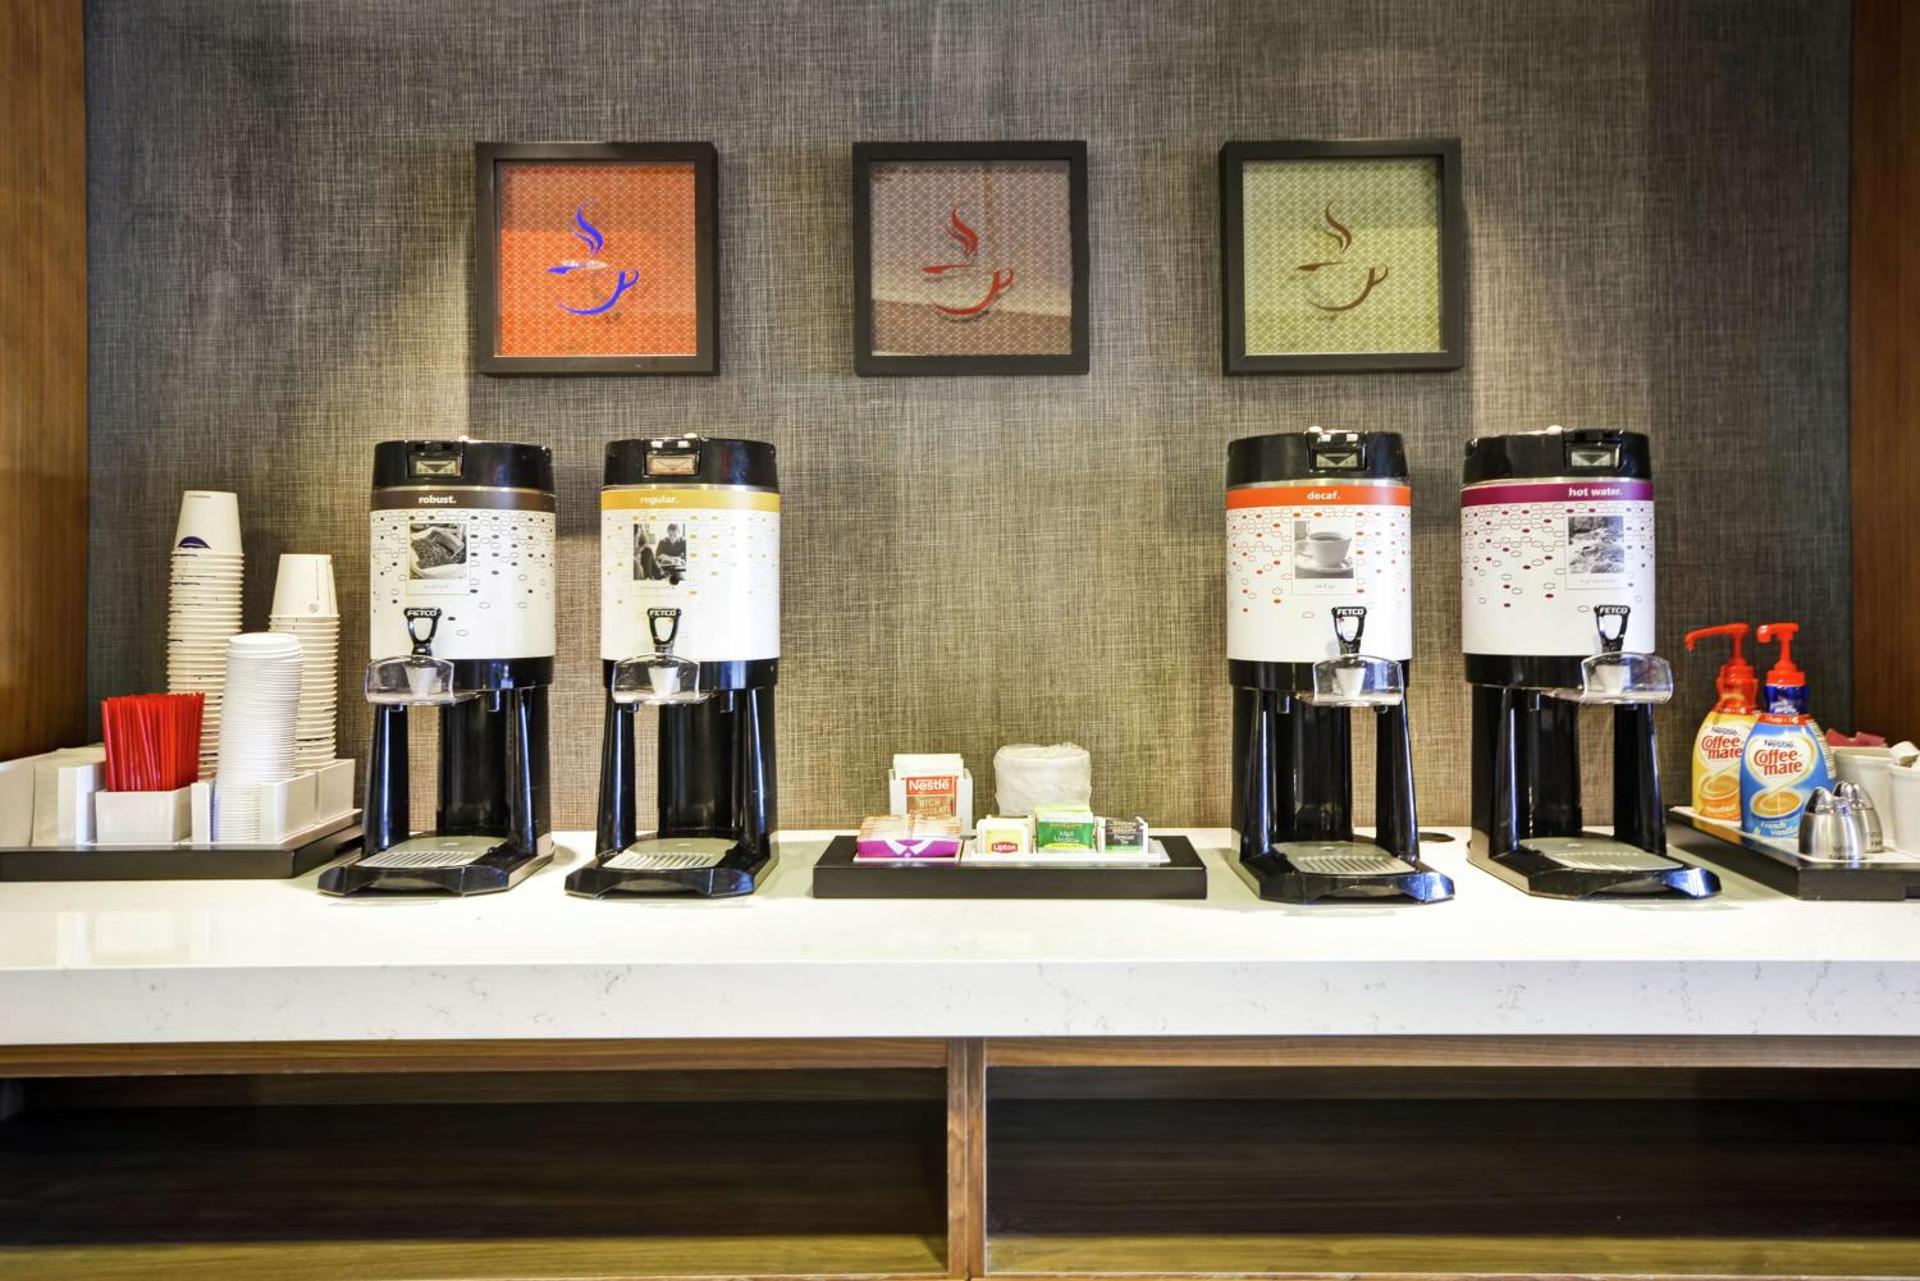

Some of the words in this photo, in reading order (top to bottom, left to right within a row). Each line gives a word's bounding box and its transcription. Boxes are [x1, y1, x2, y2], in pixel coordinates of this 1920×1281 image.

[1306, 490, 1341, 501] decaf.
[1568, 487, 1588, 497] hot
[1590, 487, 1623, 497] water.
[418, 494, 457, 504] robust.
[640, 494, 679, 506] regular.
[407, 609, 438, 618] FETCO
[649, 609, 678, 617] FETCO
[1336, 608, 1364, 616] FETCO
[1599, 606, 1628, 615] FETCO
[1708, 747, 1743, 760] mate
[1763, 761, 1803, 776] mate
[993, 843, 1017, 852] Lipton
